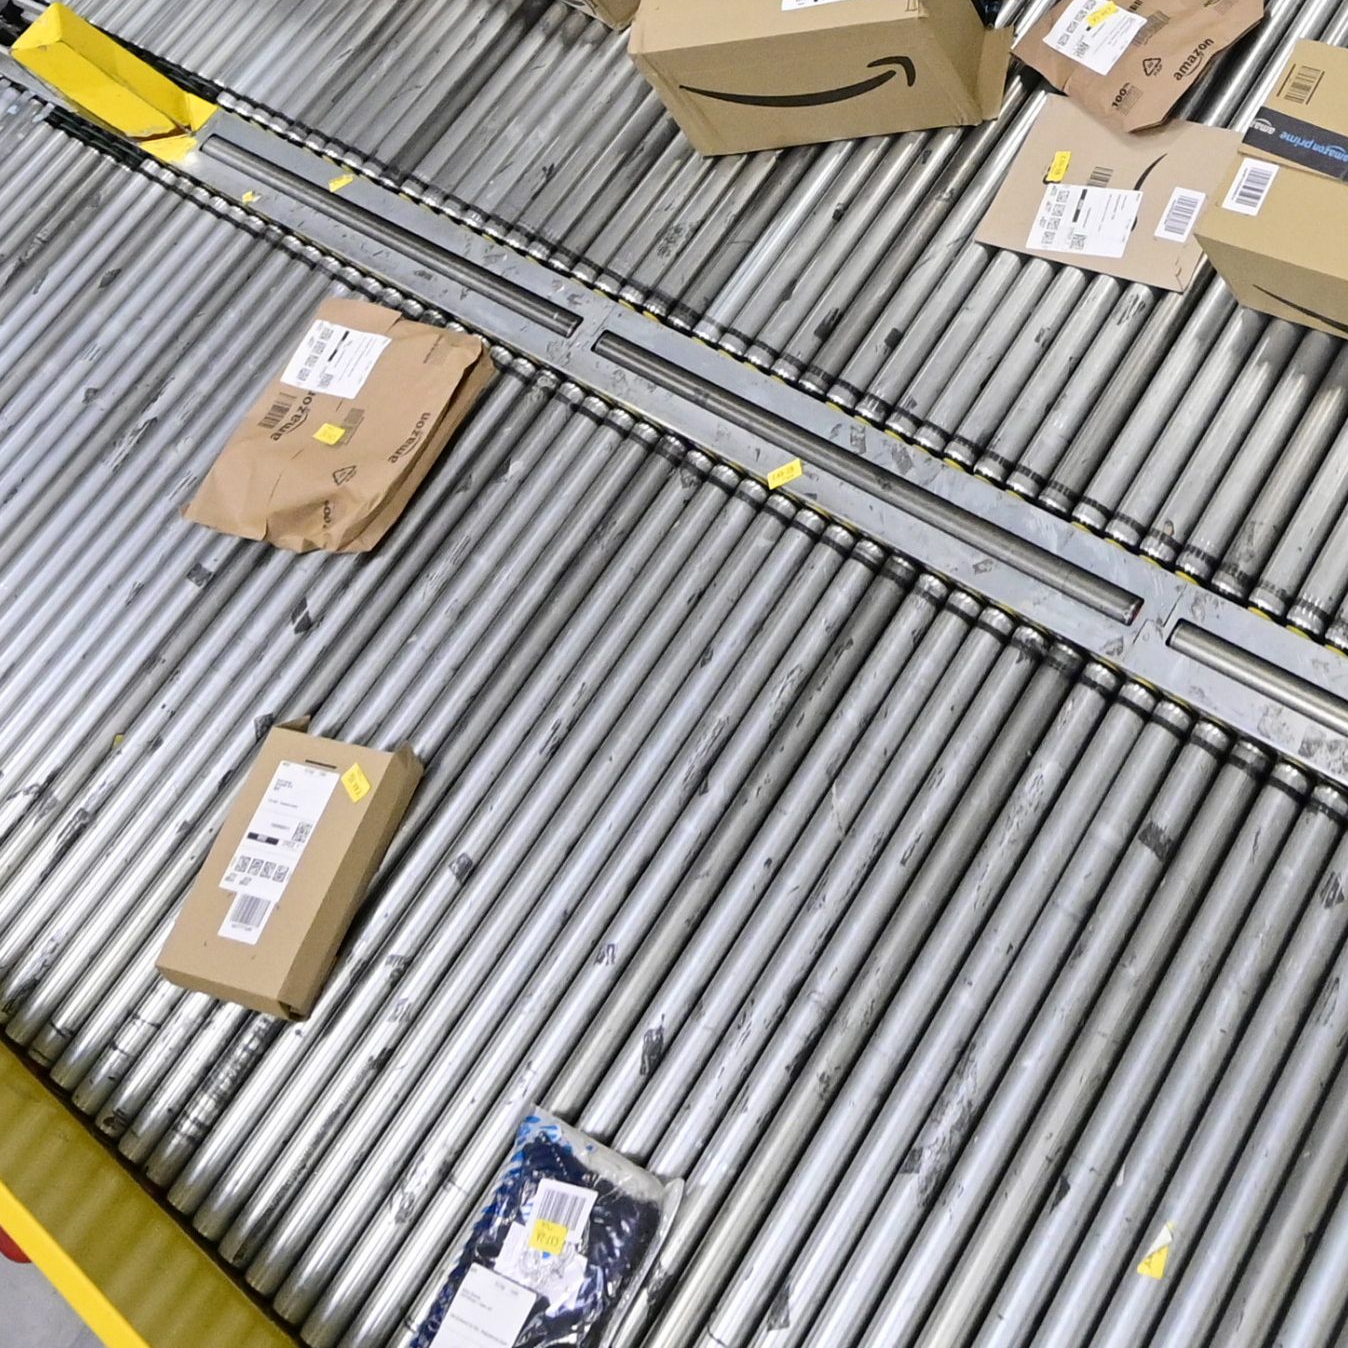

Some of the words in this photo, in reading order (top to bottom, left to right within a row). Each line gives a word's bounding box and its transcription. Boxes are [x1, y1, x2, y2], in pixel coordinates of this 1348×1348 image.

[1172, 37, 1215, 81] amazon
[1279, 130, 1312, 152] prime
[387, 410, 432, 465] amazon
